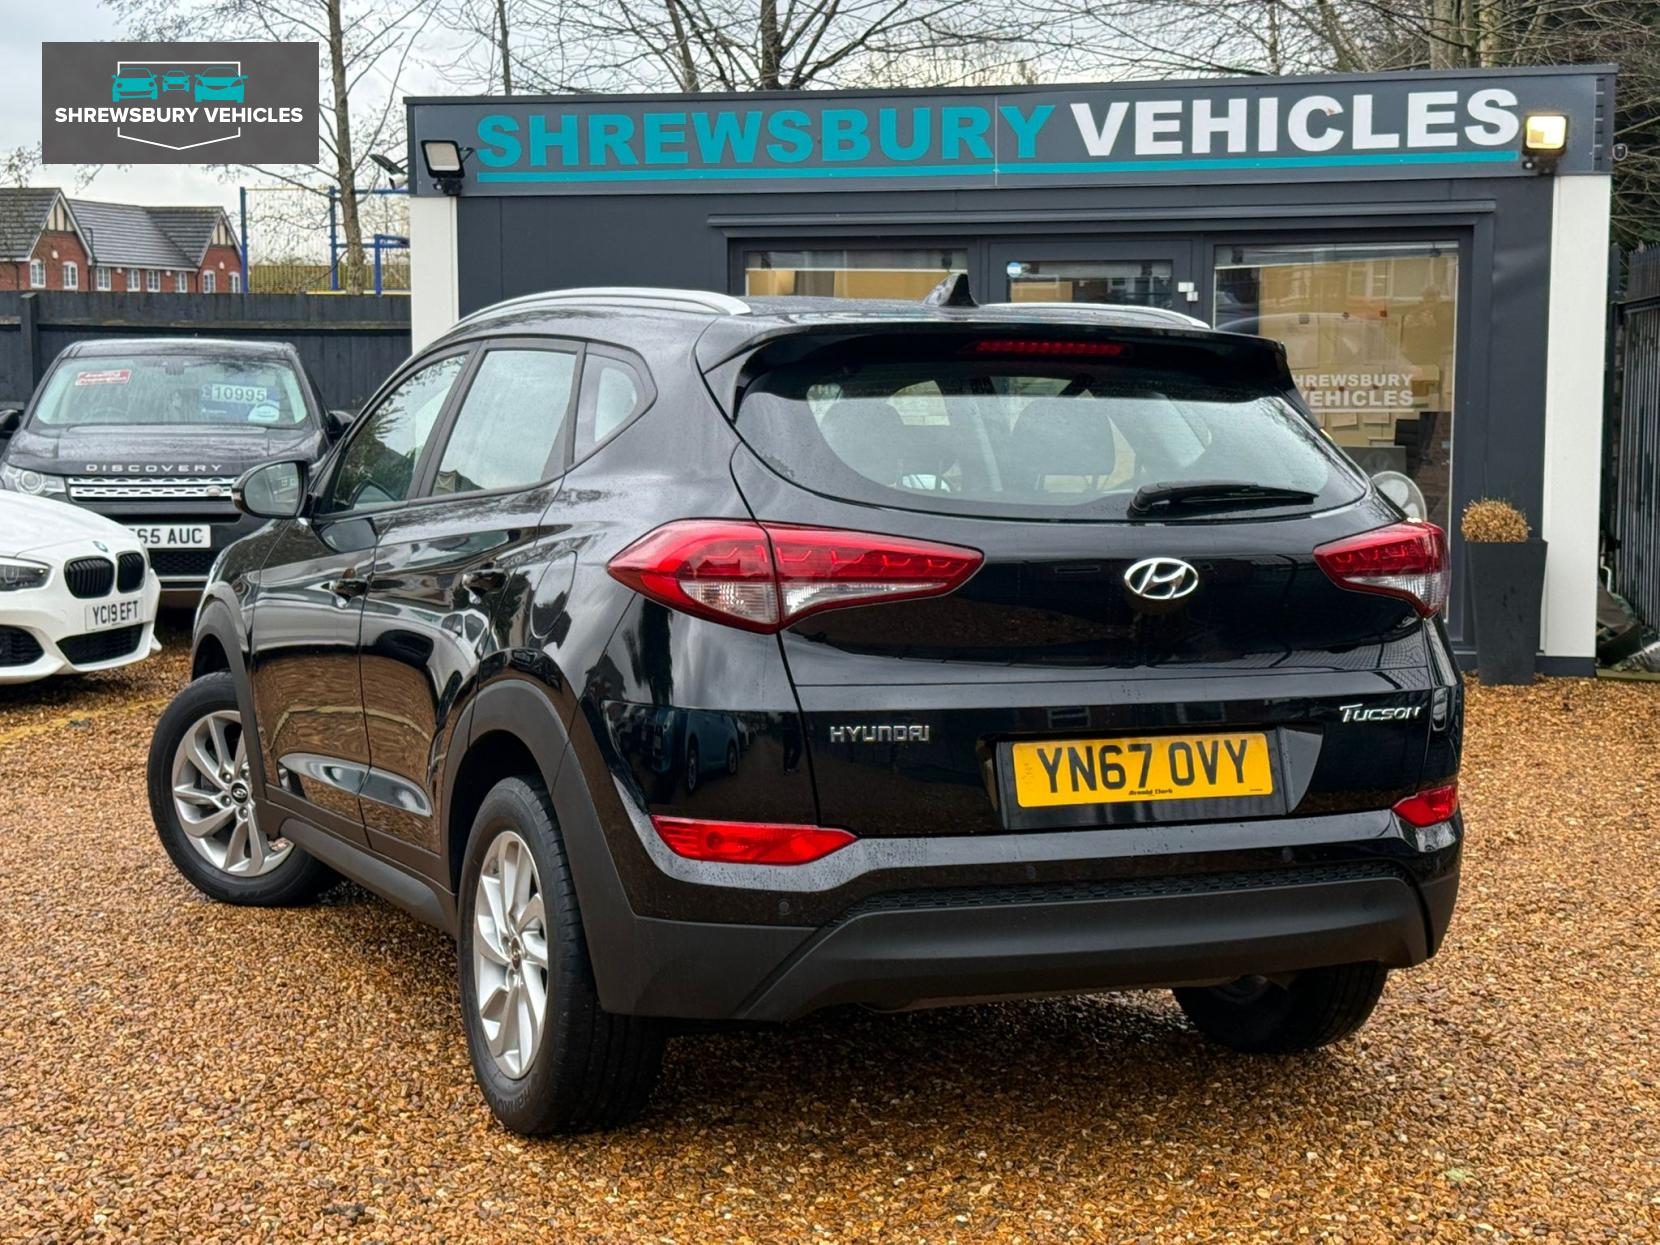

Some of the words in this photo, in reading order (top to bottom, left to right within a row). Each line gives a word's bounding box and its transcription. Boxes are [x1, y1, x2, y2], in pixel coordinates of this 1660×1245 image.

[476, 105, 1055, 167] SHREWSBURY
[1070, 87, 1519, 157] VEHICLES
[1293, 374, 1413, 387] HREWSBURY
[86, 464, 222, 472] DISCOVERY
[129, 528, 161, 544] 65
[167, 528, 202, 544] AUC
[92, 603, 117, 626] YC19
[120, 600, 138, 621] EFT
[830, 725, 930, 742] HYUNDAI
[1036, 743, 1153, 793] YN67
[1168, 739, 1248, 787] OVY
